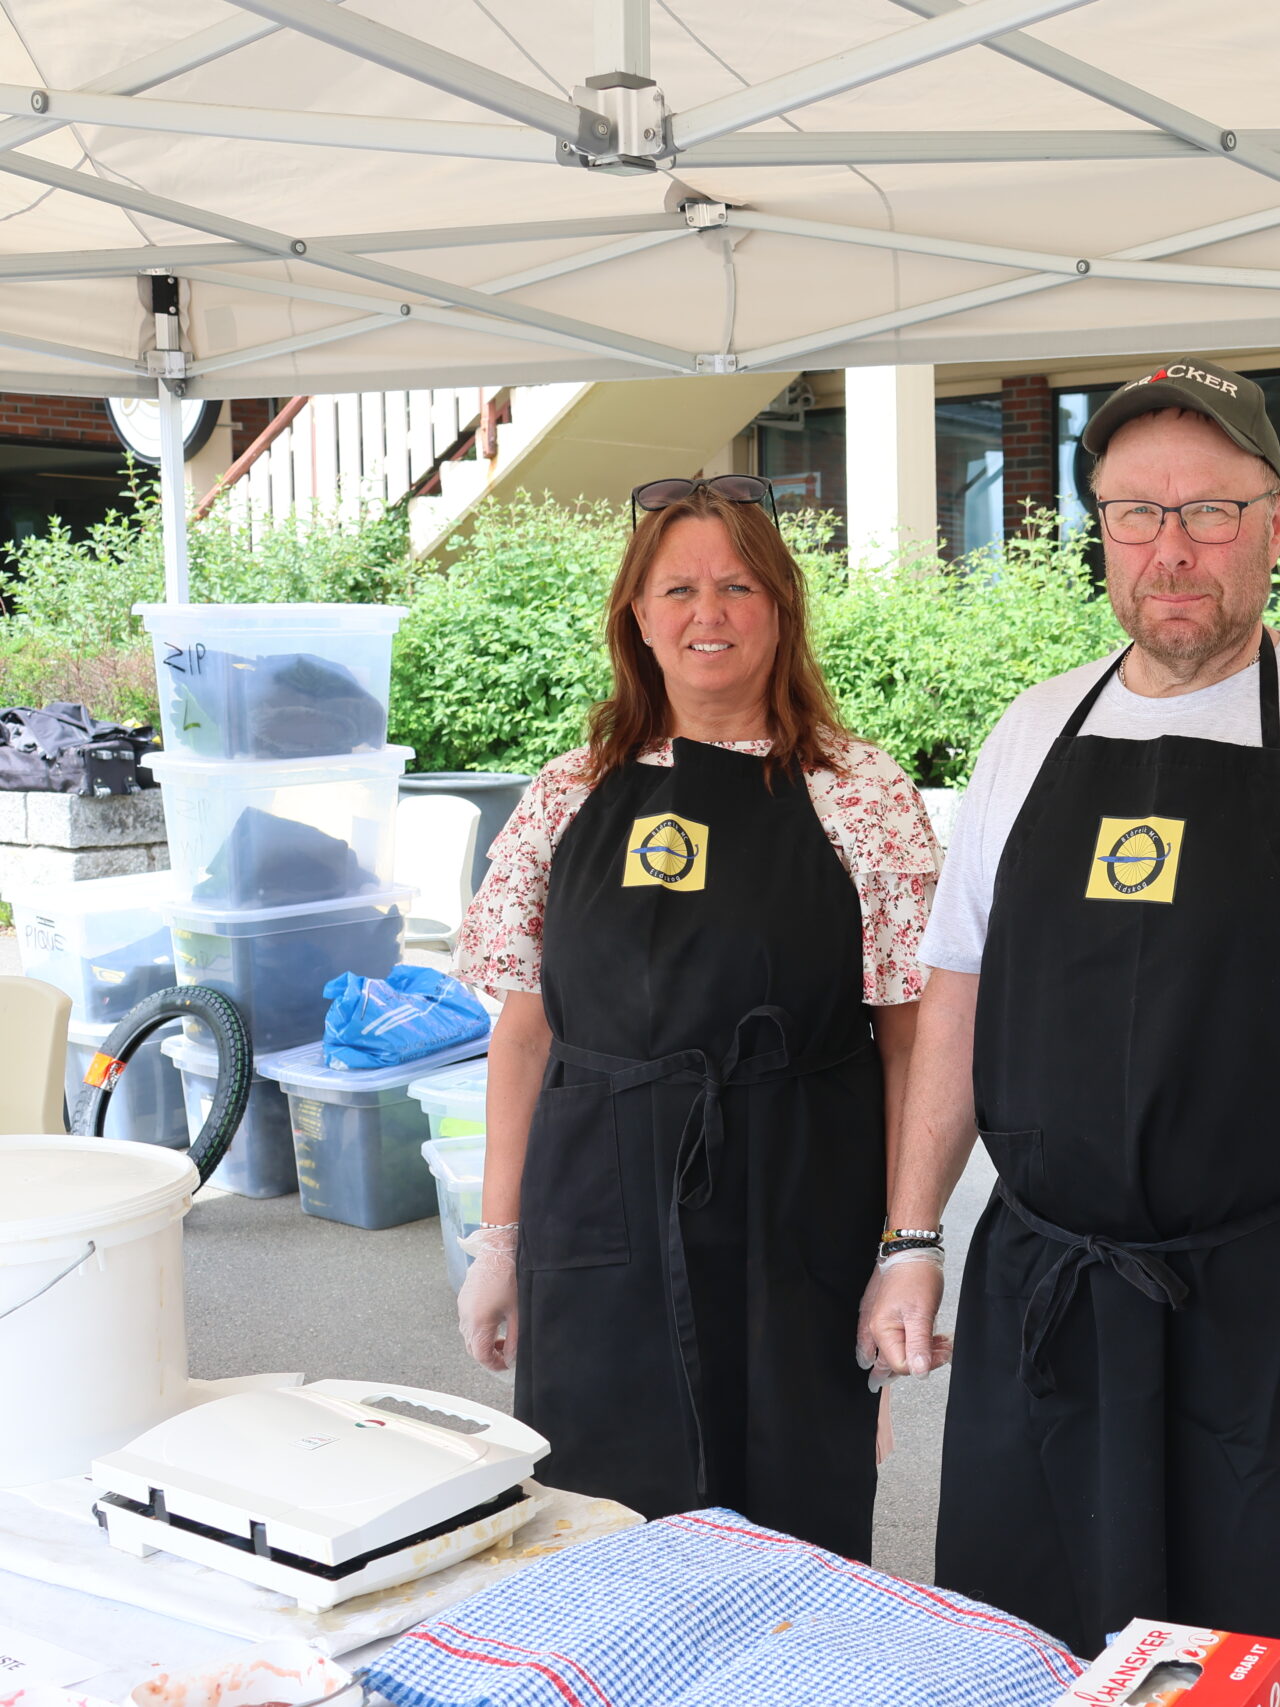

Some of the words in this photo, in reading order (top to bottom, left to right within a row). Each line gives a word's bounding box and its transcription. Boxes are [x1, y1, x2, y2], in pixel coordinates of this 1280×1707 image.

[163, 642, 206, 676] ZIP
[1229, 1654, 1260, 1681] GRAB
[1250, 1643, 1268, 1655] IT
